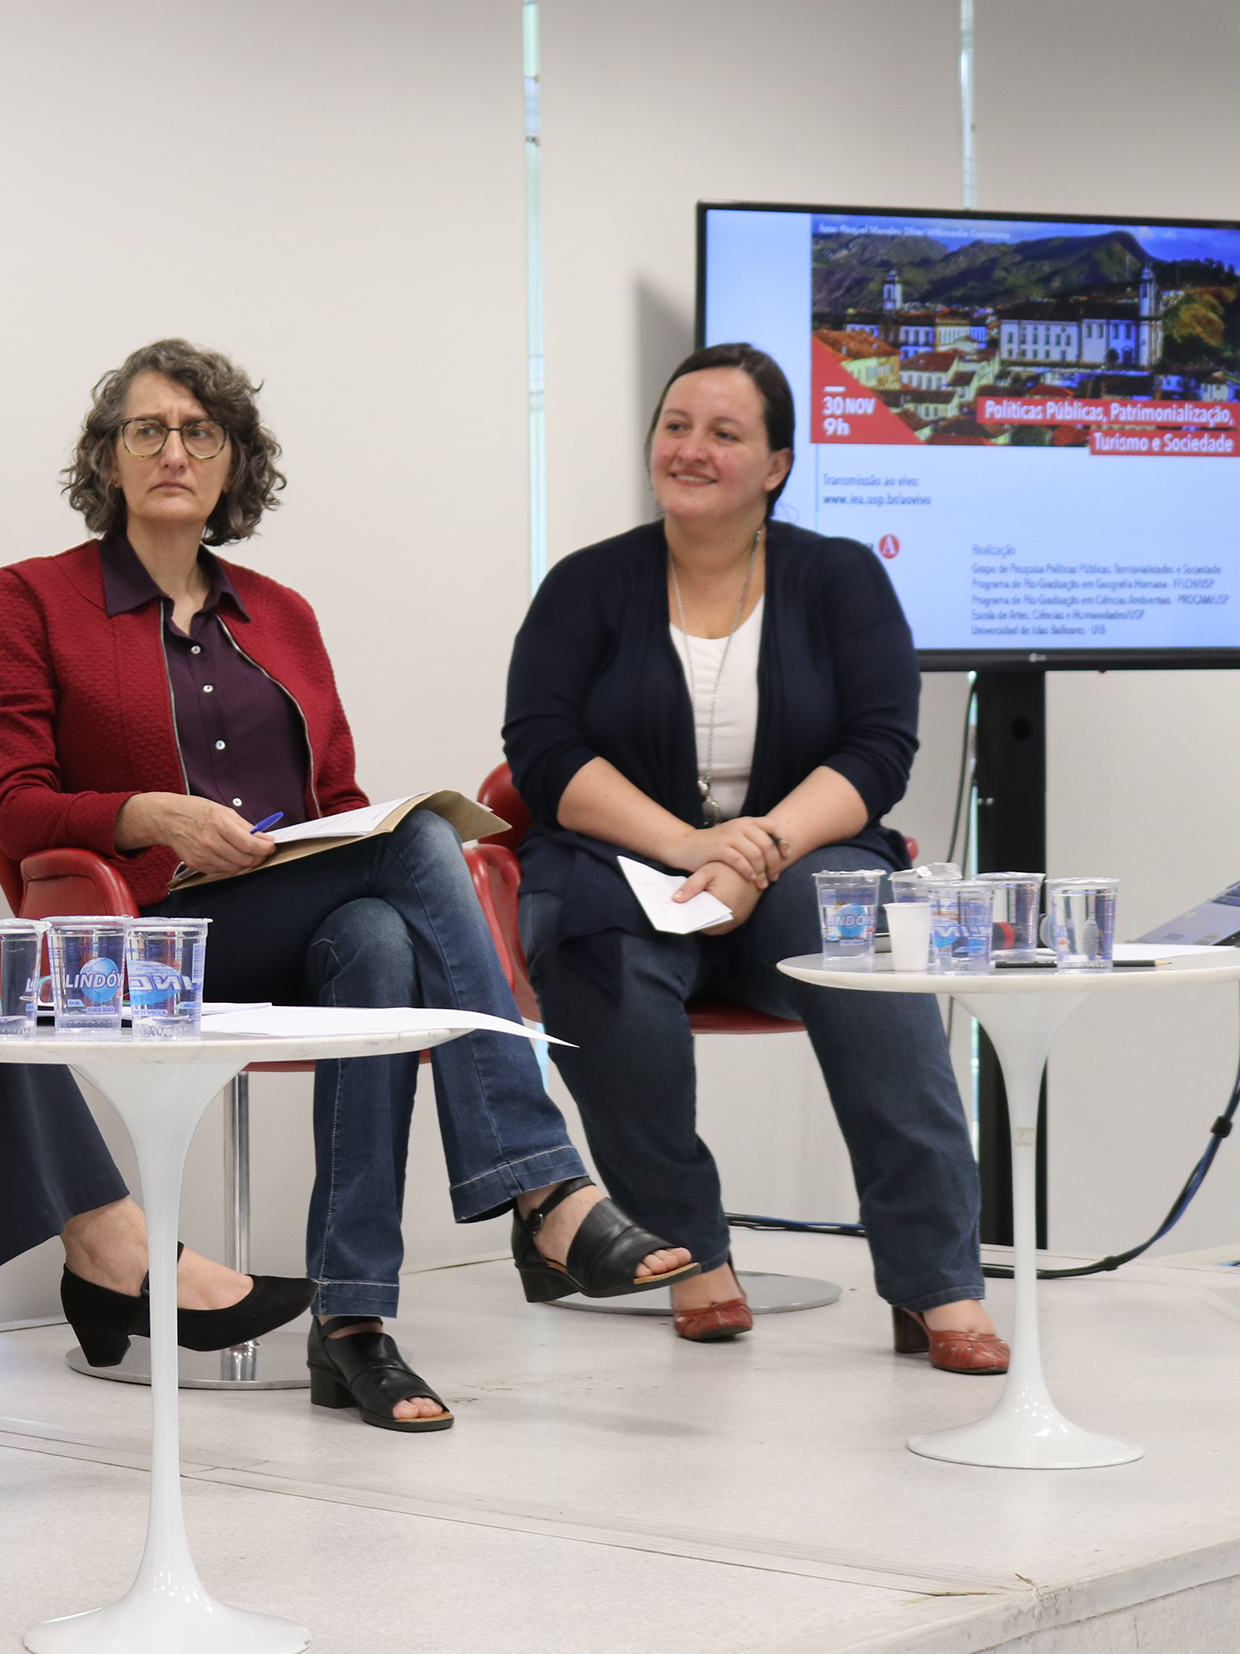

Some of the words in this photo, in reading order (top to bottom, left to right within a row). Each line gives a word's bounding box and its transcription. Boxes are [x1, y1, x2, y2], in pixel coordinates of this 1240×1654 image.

[823, 396, 844, 415] 30
[845, 397, 876, 415] NOV
[985, 400, 1043, 419] Políticas
[1046, 400, 1108, 423] Públicas,
[1110, 402, 1235, 427] Patrimonialização,
[823, 417, 850, 436] 9h
[1093, 432, 1149, 451] Turismo
[1151, 436, 1161, 451] e
[1163, 433, 1235, 452] Sociedade
[823, 473, 880, 486] Transmissão
[883, 477, 895, 486] ao
[898, 474, 921, 486] vivo:
[971, 543, 1016, 559] Realização
[971, 563, 996, 575] Grupo
[998, 564, 1008, 574] de
[1010, 563, 1044, 576] Pesquisa
[1046, 563, 1077, 574] Políticas
[1114, 563, 1174, 574] Territorialidades
[1176, 566, 1181, 574] e
[1183, 563, 1221, 574] Sociedade
[971, 578, 1009, 592] Programa
[1011, 578, 1021, 589] de
[1023, 578, 1079, 591] Pós-Graduação
[1081, 581, 1094, 589] em
[1095, 578, 1133, 592] Geografia
[1134, 578, 1167, 589] Humana
[971, 594, 1009, 608] Programa
[1011, 594, 1021, 605] de
[1023, 594, 1079, 608] Pós-Graduação
[1081, 597, 1094, 605] em
[1095, 594, 1127, 605] Ciências
[1128, 594, 1171, 605] Ambientais
[971, 609, 995, 620] Escola
[997, 610, 1007, 620] de
[1032, 609, 1064, 620] Ciências
[1066, 612, 1071, 620] e
[1020, 625, 1030, 635] de
